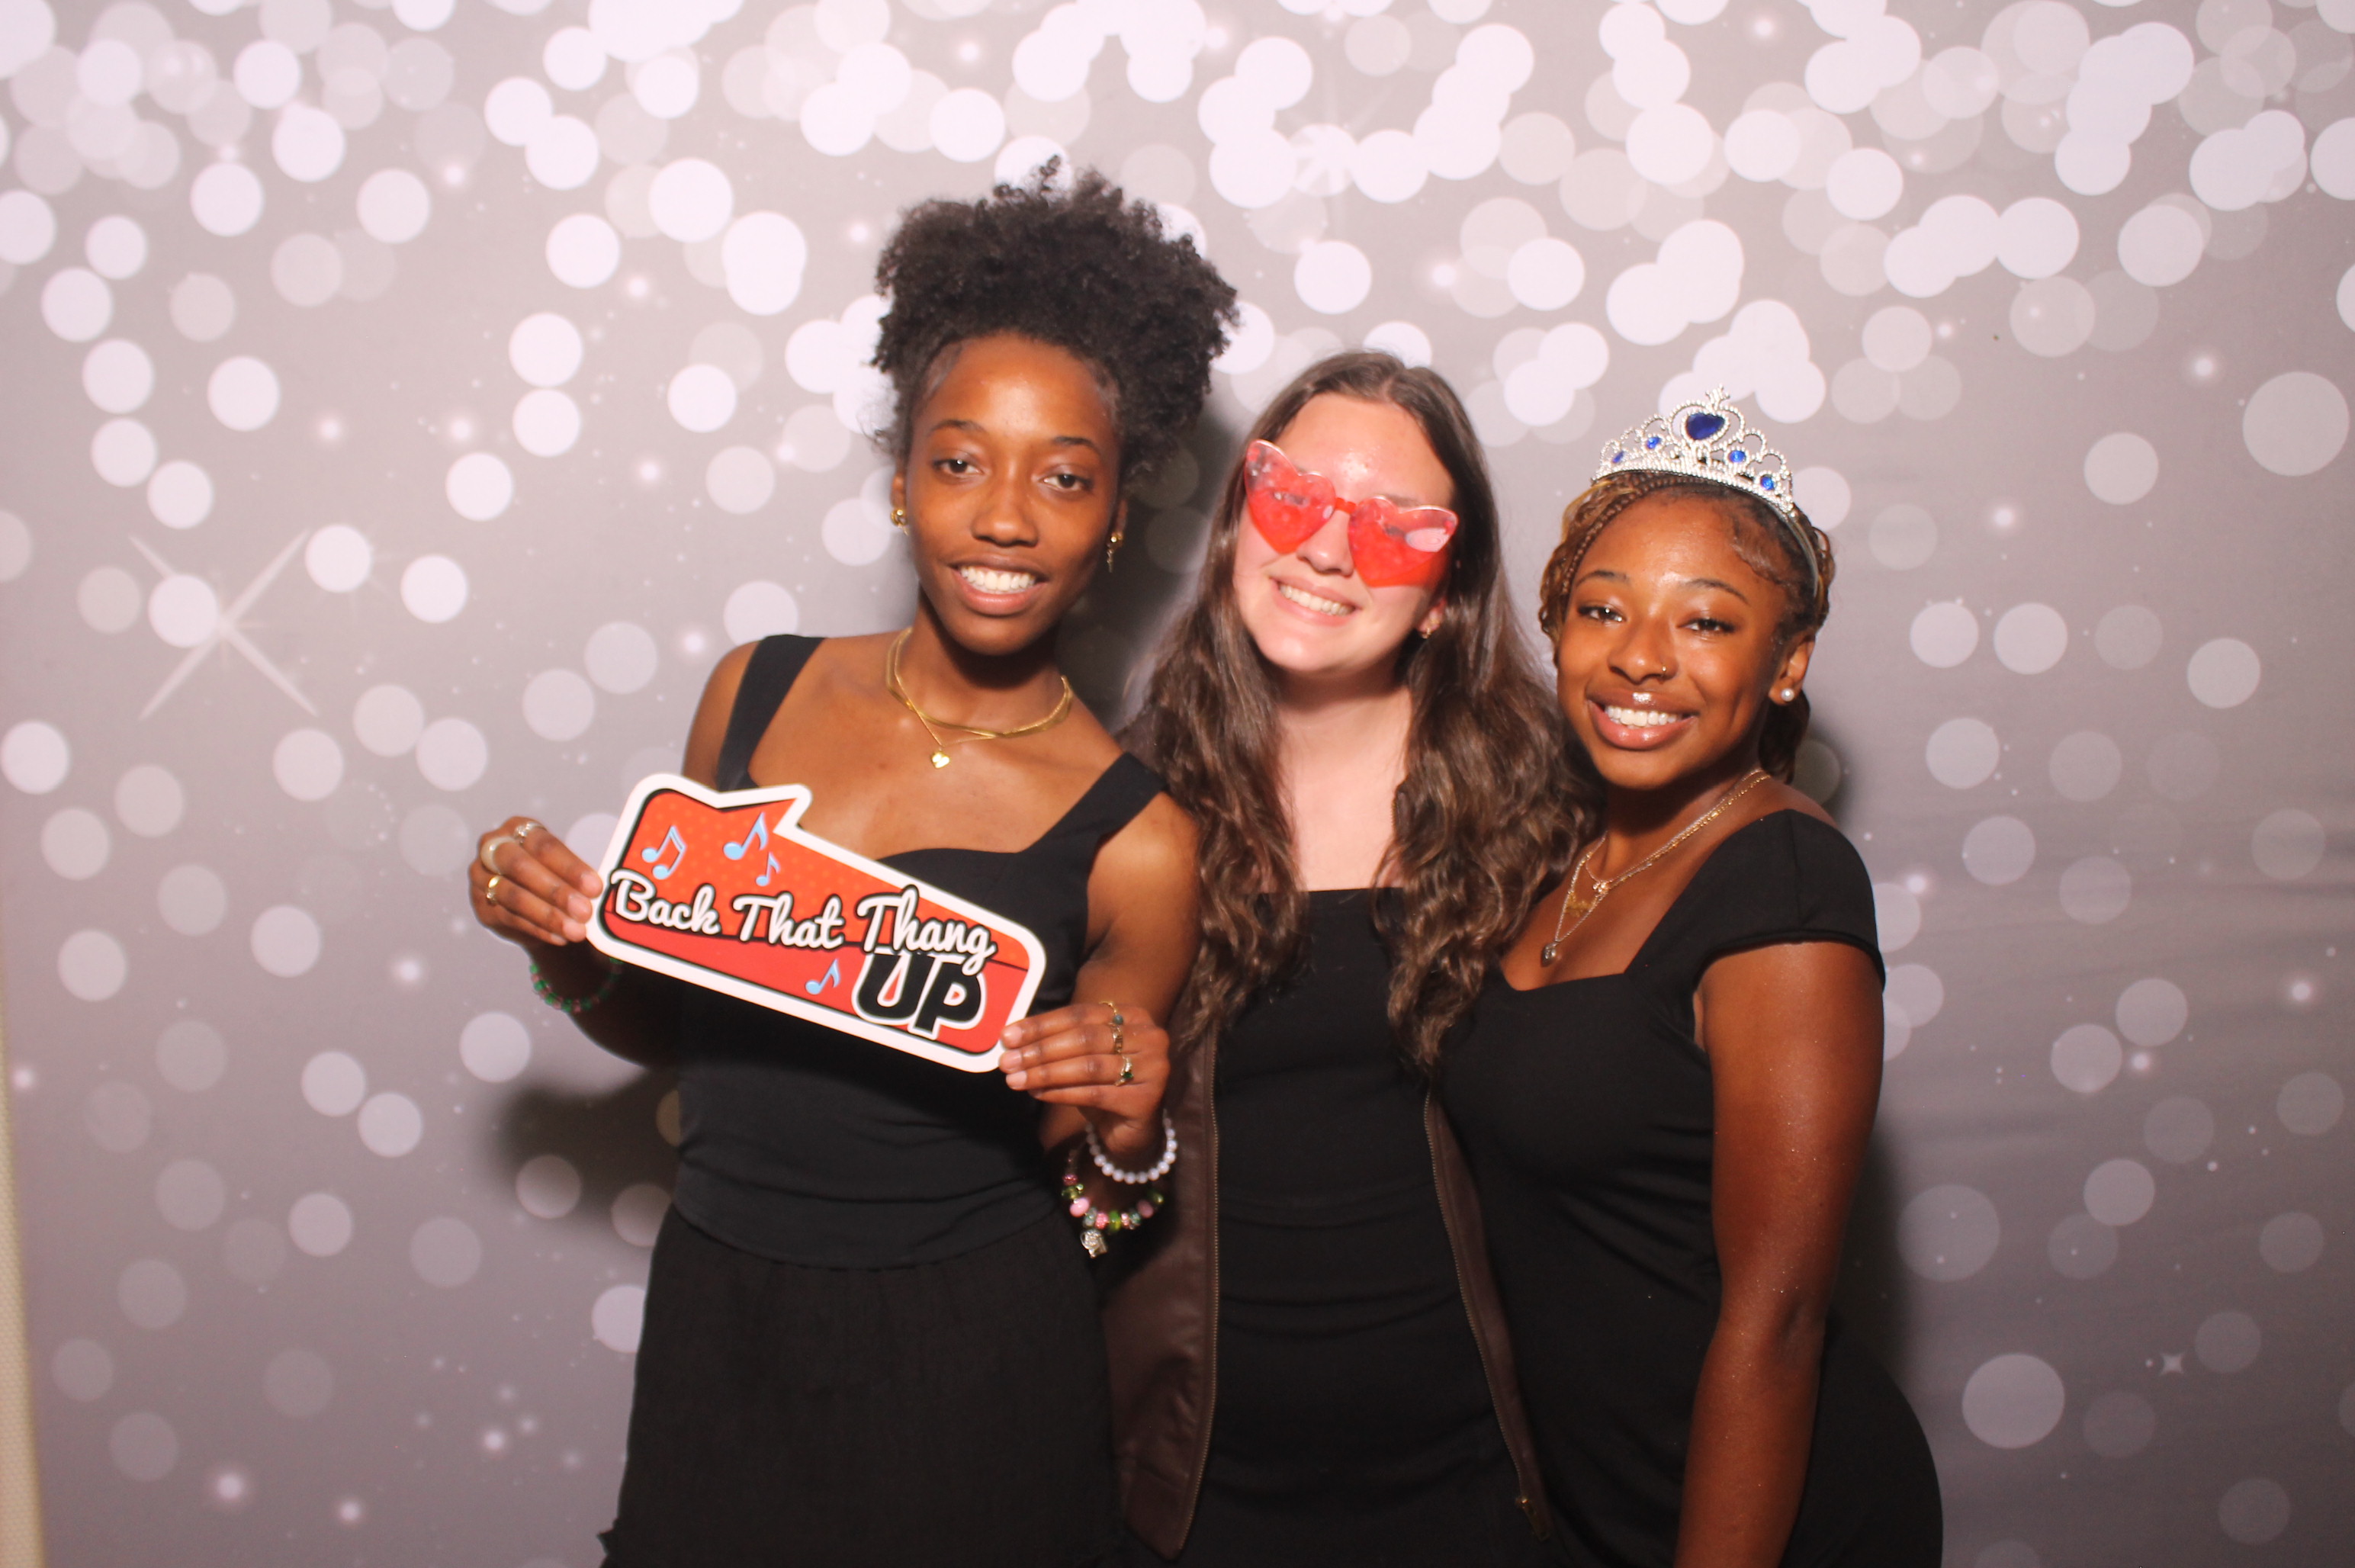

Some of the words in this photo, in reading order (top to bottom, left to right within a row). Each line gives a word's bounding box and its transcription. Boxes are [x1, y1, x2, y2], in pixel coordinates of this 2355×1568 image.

[610, 868, 721, 936] Back
[732, 891, 845, 949] That
[856, 885, 998, 976] Thang
[852, 950, 985, 1039] UP
